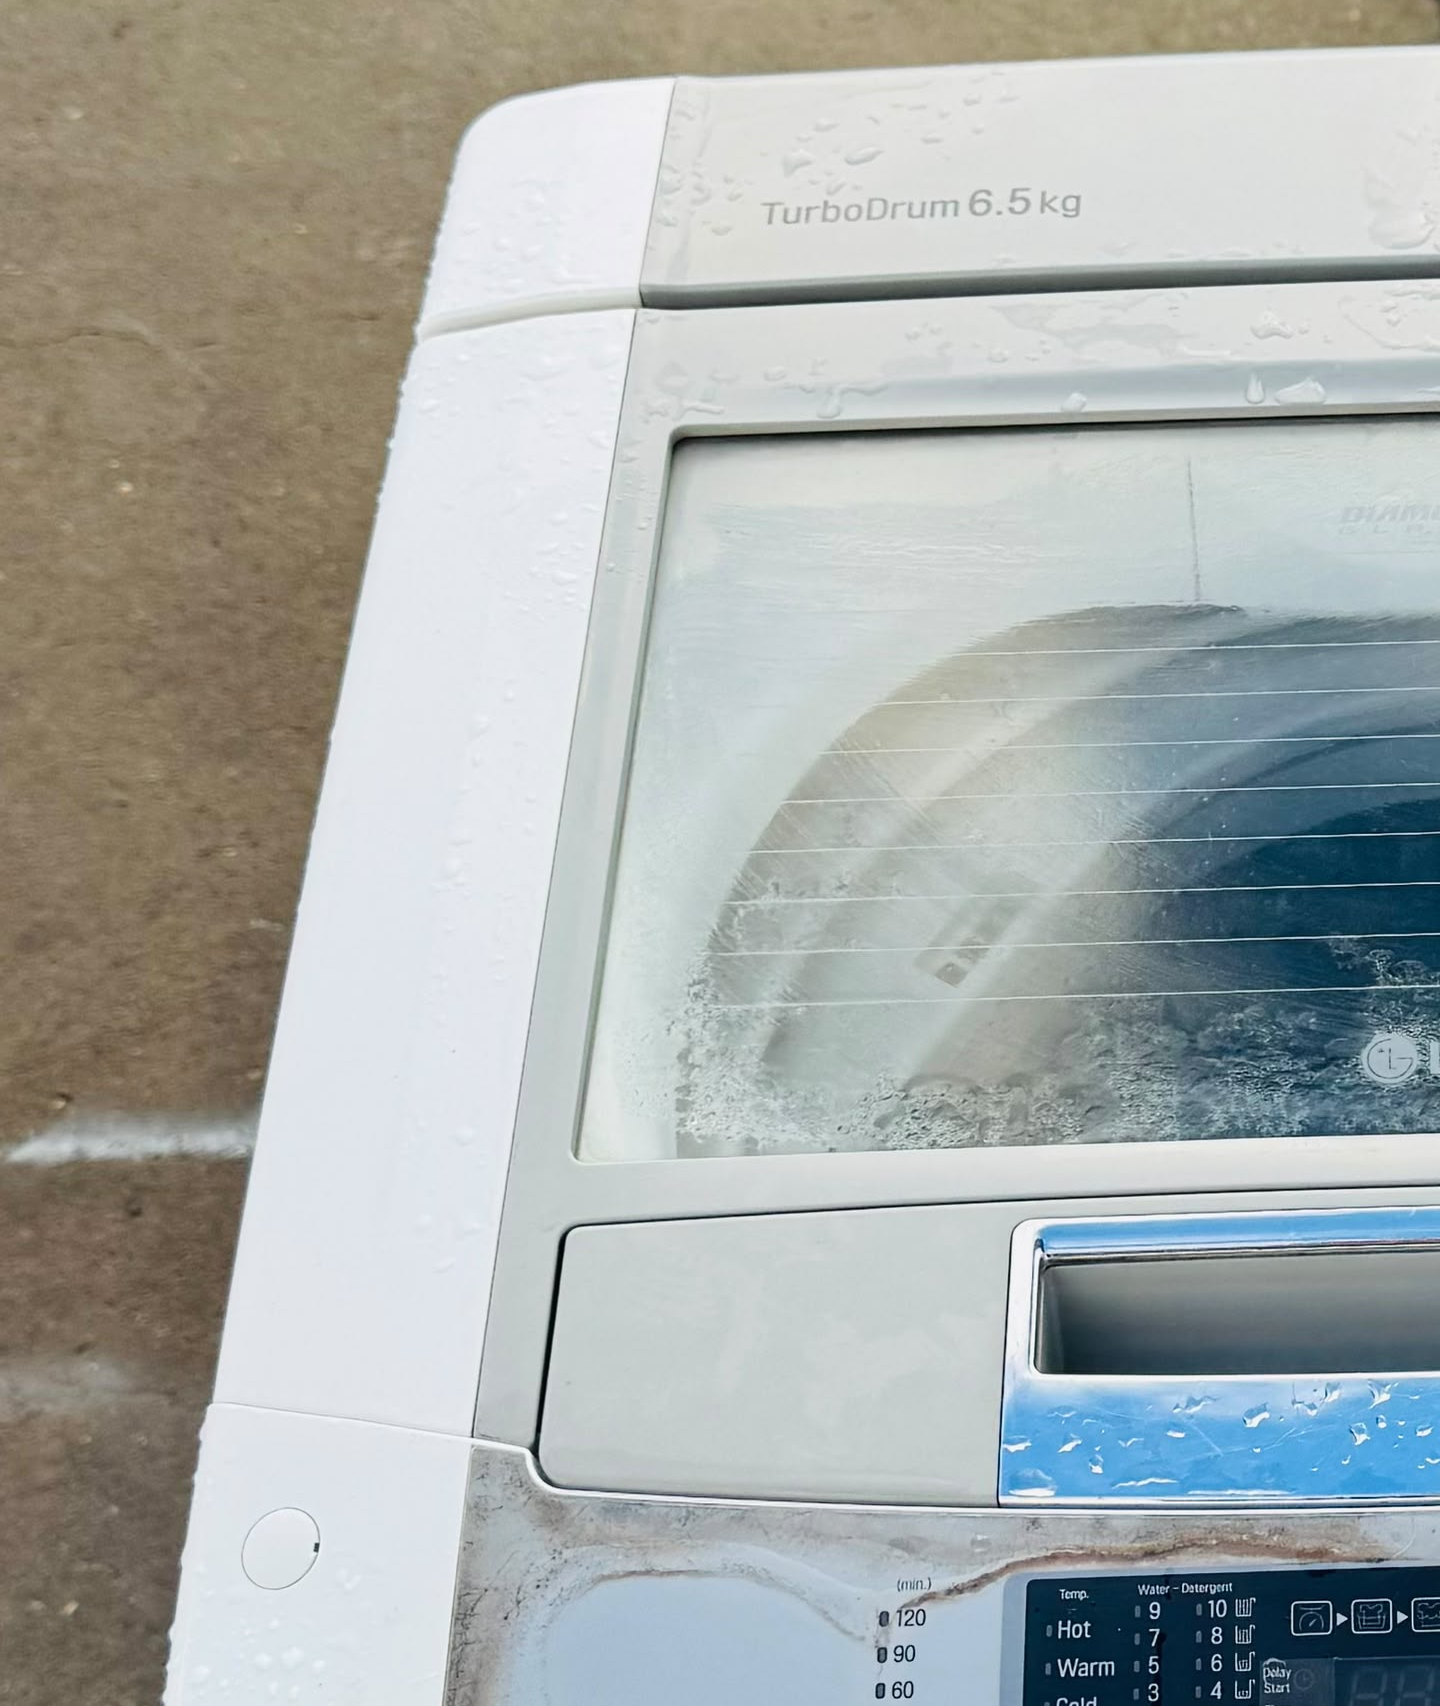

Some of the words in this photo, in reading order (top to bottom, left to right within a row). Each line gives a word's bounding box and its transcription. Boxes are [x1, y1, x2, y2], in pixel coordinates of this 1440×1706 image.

[761, 197, 960, 226] TurboDrum
[967, 187, 1032, 217] 6.5
[1039, 190, 1082, 219] kg
[896, 1577, 932, 1592] (min.)
[1137, 1583, 1170, 1596] Water
[895, 1608, 927, 1628] 120
[1148, 1601, 1161, 1620] 9
[1207, 1598, 1228, 1619] 10
[1057, 1619, 1092, 1640] Hot
[1148, 1628, 1160, 1647] 7
[1210, 1626, 1223, 1645] 8
[893, 1644, 916, 1663] 90
[1210, 1653, 1223, 1672] 6
[1057, 1657, 1115, 1678] Warm
[1148, 1655, 1160, 1674] 5
[891, 1680, 914, 1700] 60
[1147, 1683, 1160, 1702] 3
[1209, 1680, 1223, 1700] 4
